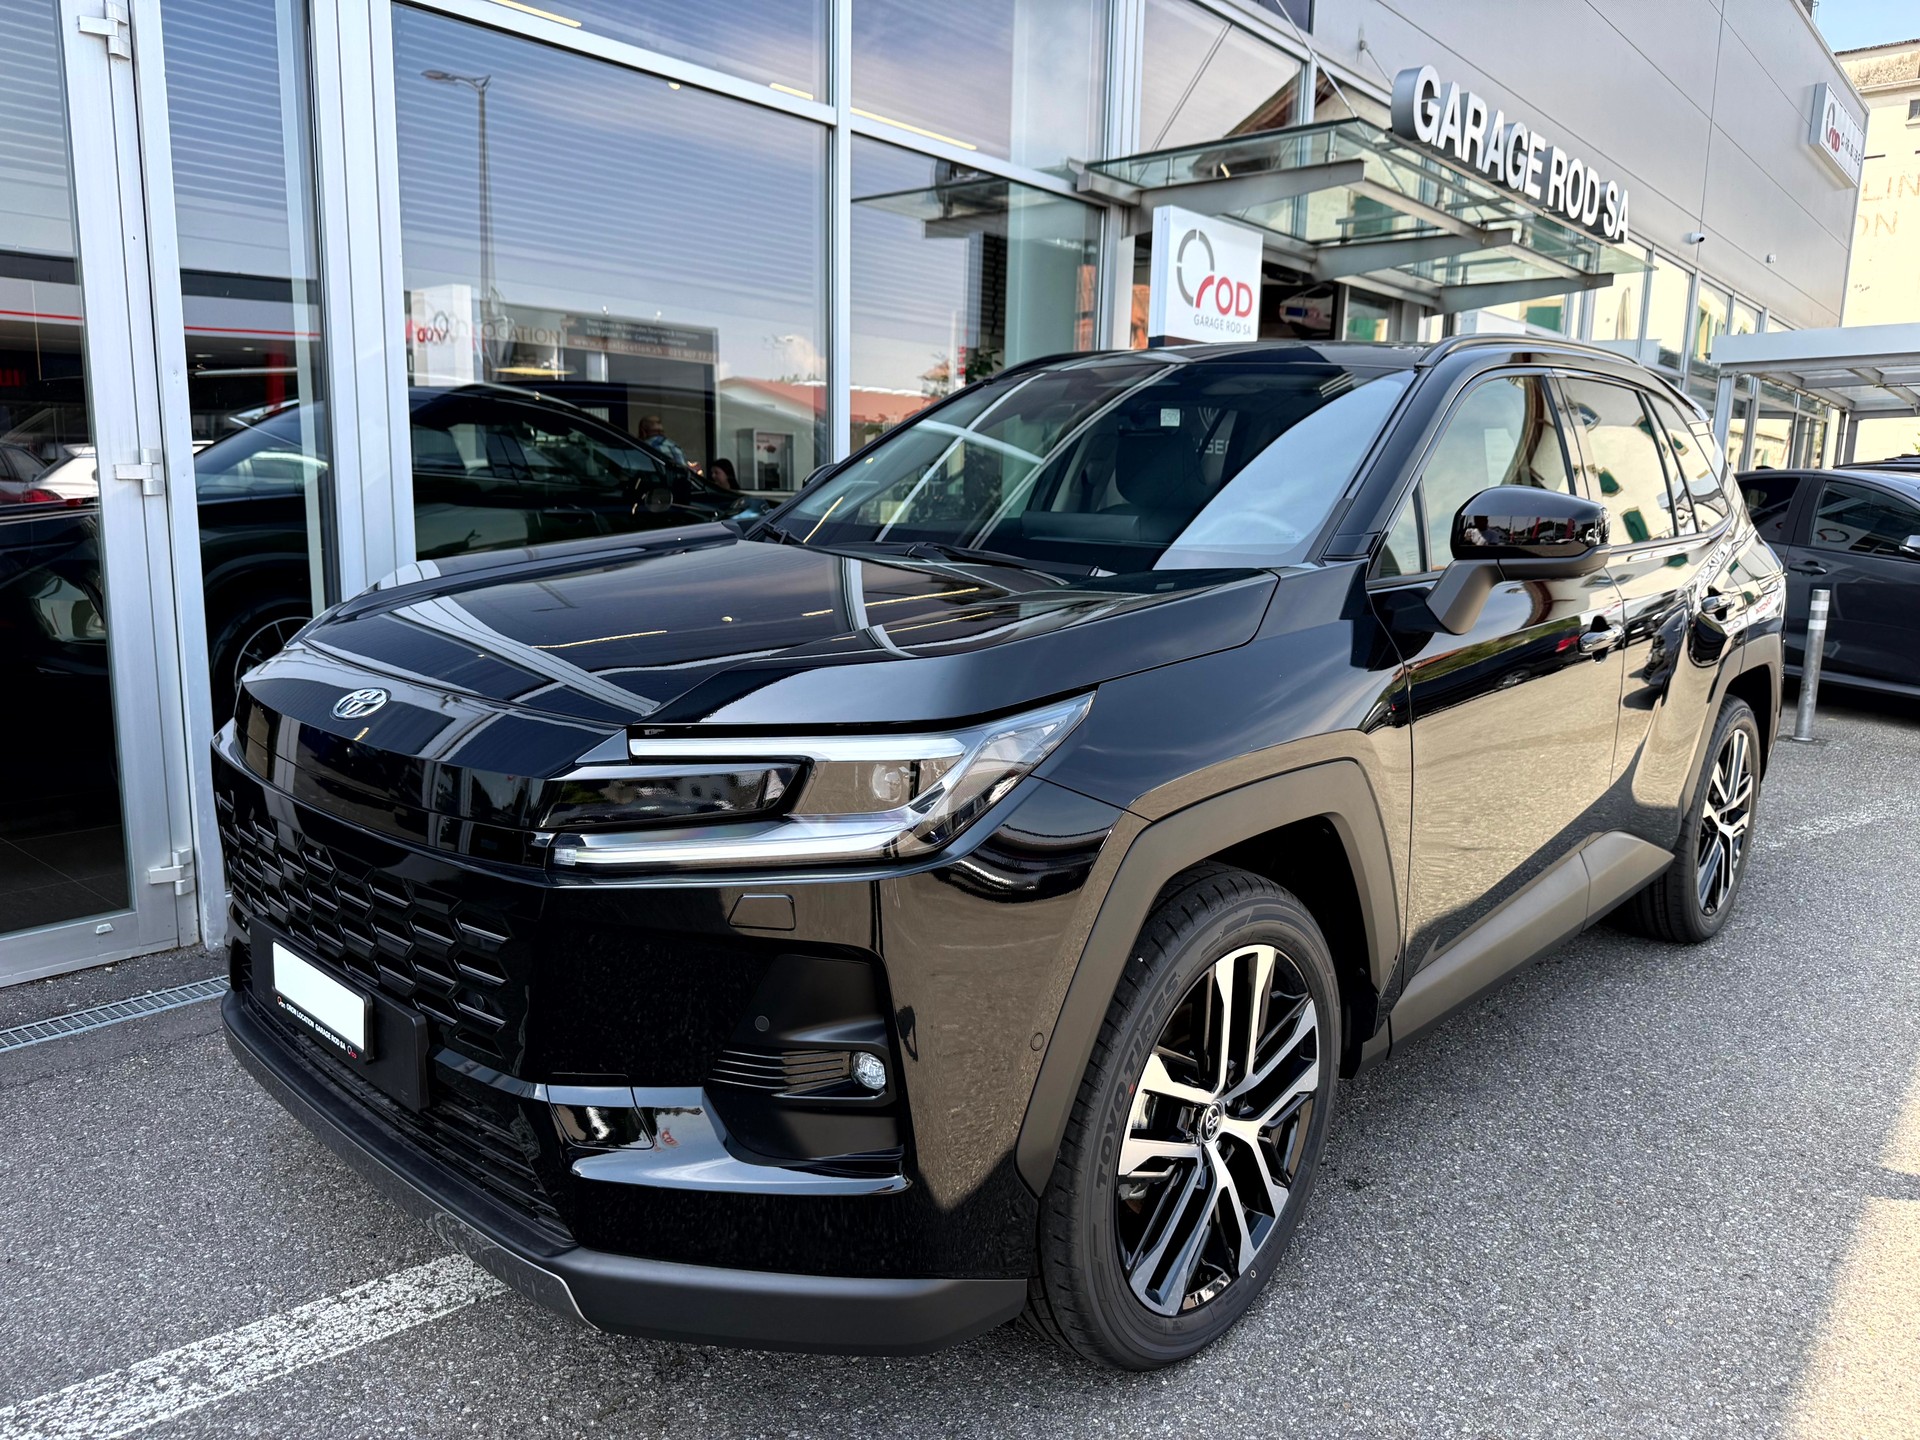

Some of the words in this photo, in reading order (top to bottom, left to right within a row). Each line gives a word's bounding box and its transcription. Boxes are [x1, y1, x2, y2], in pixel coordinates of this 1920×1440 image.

[1413, 64, 1546, 199] GARAGE
[1547, 146, 1600, 226] ROD
[1603, 180, 1629, 244] SA
[1194, 314, 1224, 330] GARAGE
[1226, 321, 1241, 334] ROD
[1243, 324, 1251, 335] SA
[1096, 1080, 1126, 1191] TOYO
[1123, 971, 1180, 1083] TIRES
